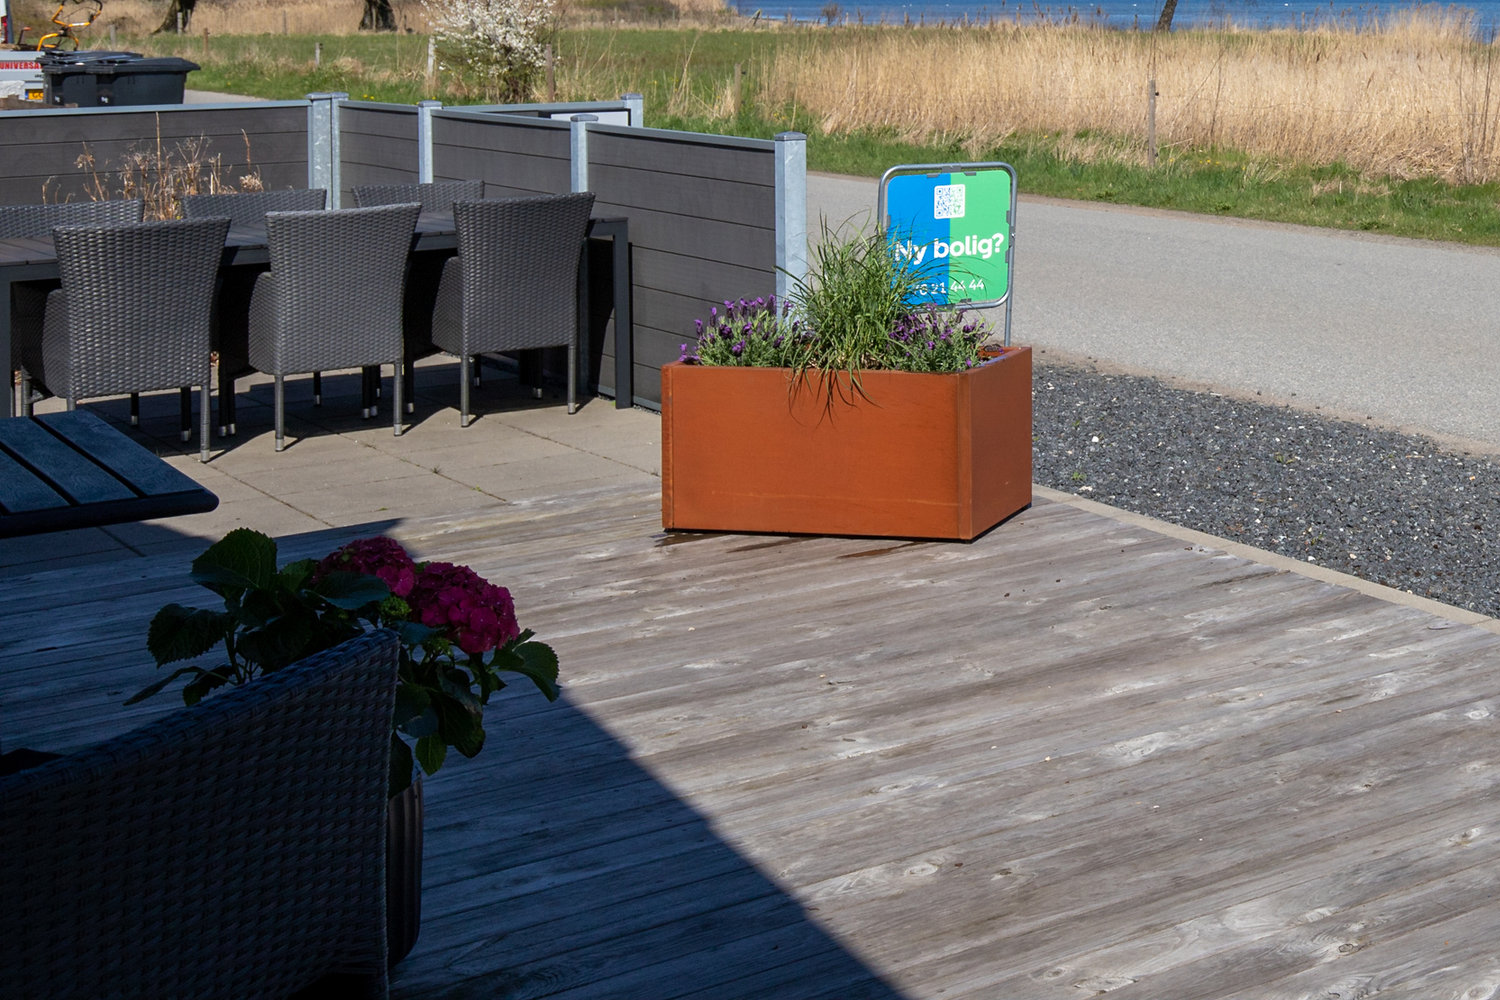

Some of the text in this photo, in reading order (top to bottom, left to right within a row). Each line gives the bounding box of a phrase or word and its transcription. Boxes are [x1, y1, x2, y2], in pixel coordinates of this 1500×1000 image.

[0, 61, 43, 69] UNIVERSA
[895, 233, 1004, 265] Ny bolig?
[931, 282, 947, 294] 21
[950, 280, 965, 292] 44
[969, 278, 985, 290] 44
